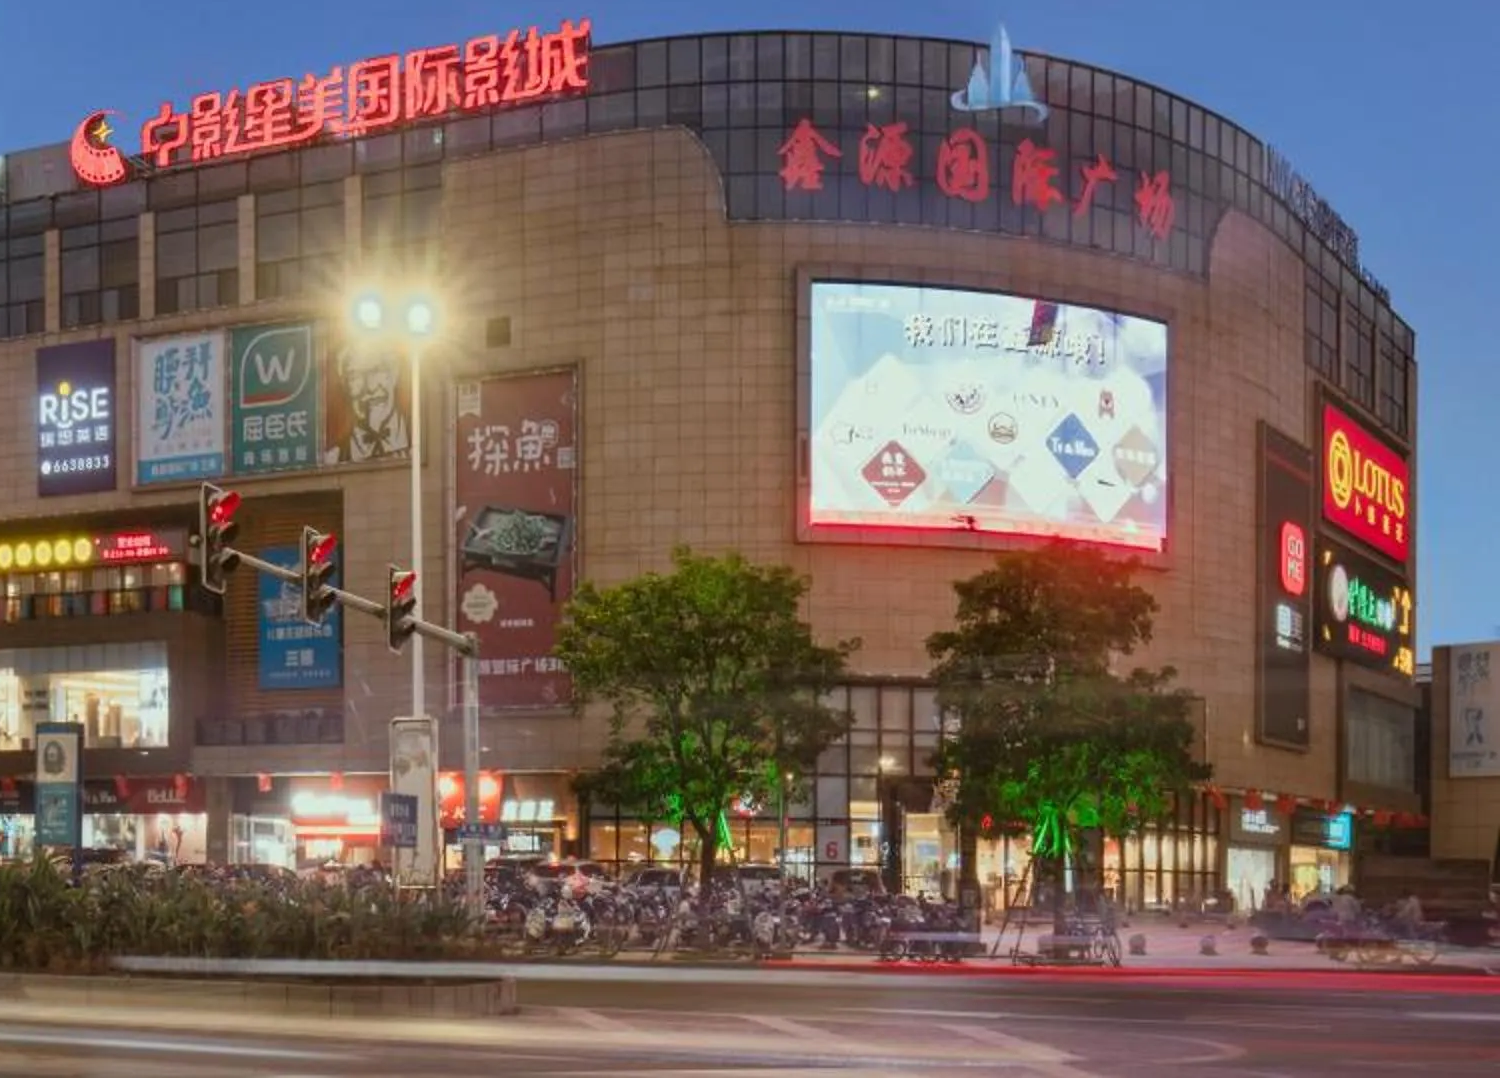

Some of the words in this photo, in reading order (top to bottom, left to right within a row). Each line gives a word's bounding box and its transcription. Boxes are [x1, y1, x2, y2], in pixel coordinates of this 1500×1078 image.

[140, 18, 593, 167] 中影星美国际影城
[776, 117, 1177, 241] 鑫源国际广场
[242, 409, 308, 443] 屈臣氏
[1353, 449, 1405, 520] LOTUS
